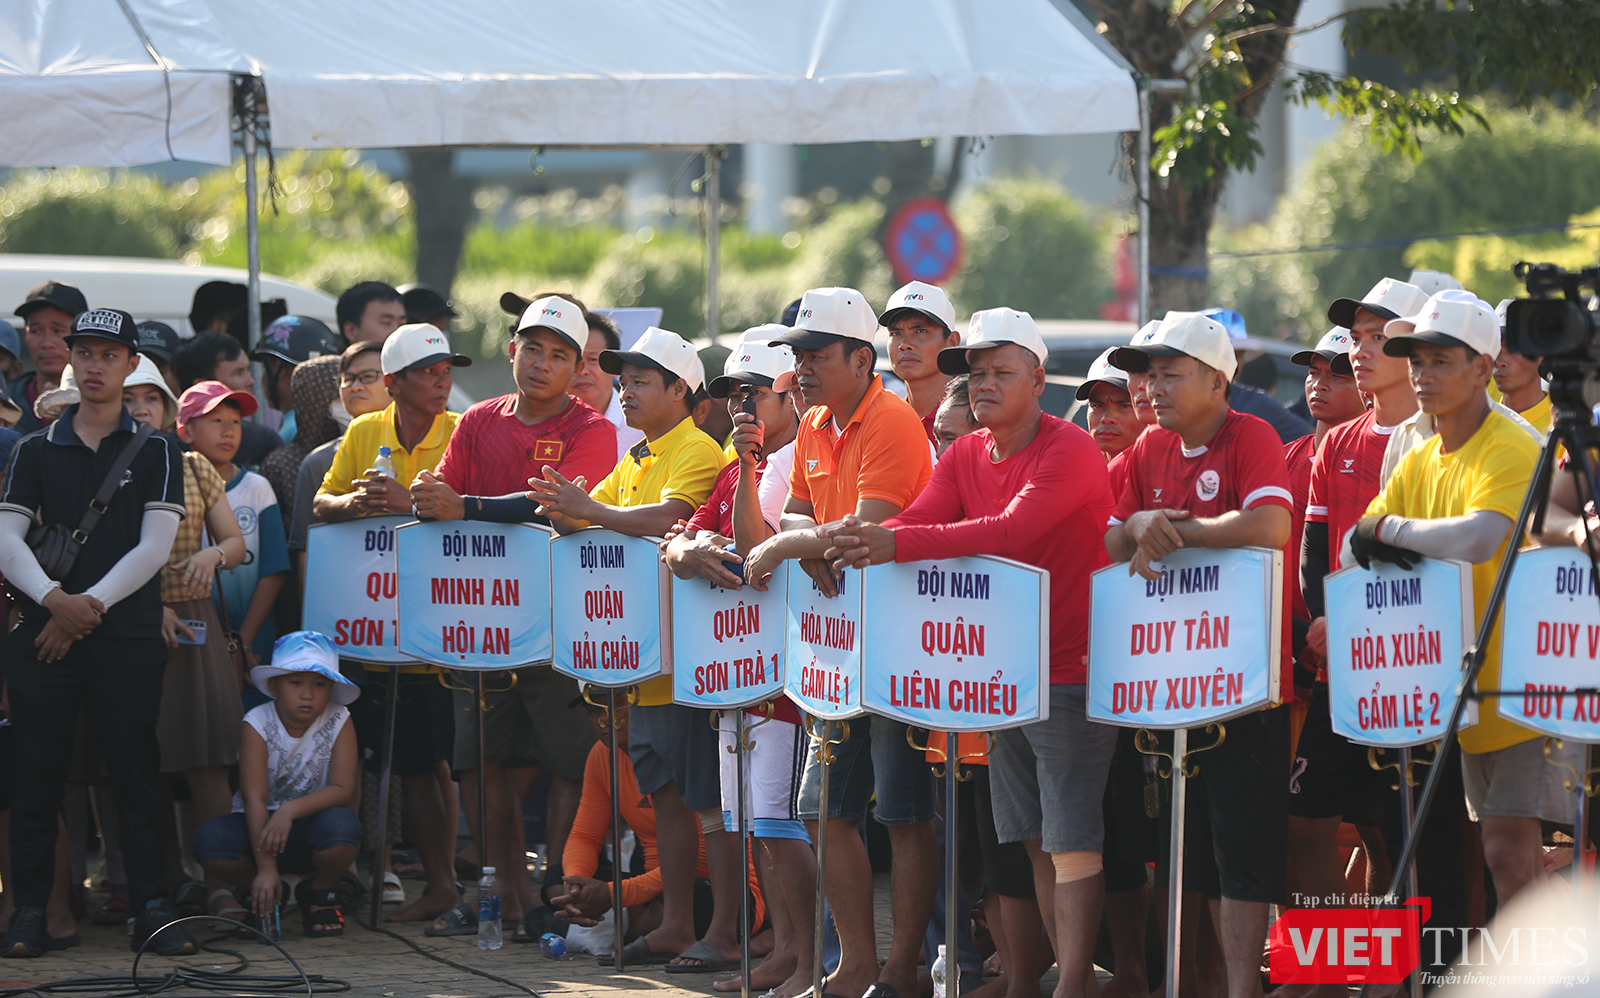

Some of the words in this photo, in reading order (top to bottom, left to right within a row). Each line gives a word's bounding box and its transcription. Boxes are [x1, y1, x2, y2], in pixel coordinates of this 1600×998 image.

[98, 316, 119, 327] YORK
[542, 309, 562, 318] VTV8
[365, 525, 394, 556] ĐỘI
[442, 530, 466, 561] ĐỘI
[472, 535, 505, 557] NAM
[580, 541, 598, 573] ĐỘI
[600, 546, 624, 568] NAM
[432, 578, 484, 605] MINH
[492, 579, 519, 606] AN
[918, 566, 945, 601] ĐỘI
[951, 573, 989, 599] NAM
[1146, 565, 1174, 602] ĐỘI
[1180, 566, 1219, 593] NAM
[1366, 576, 1386, 614] ĐỘI
[1392, 578, 1420, 605] NAM
[1556, 561, 1583, 602] ĐỘI
[585, 585, 623, 625] QUẬN
[714, 601, 759, 642] QUẬN
[335, 617, 383, 645] SƠN
[443, 621, 474, 659] HỘI
[483, 628, 509, 654] AN
[801, 606, 821, 645] HÒA
[825, 613, 855, 651] XUÂN
[922, 617, 984, 662] QUẬN
[1131, 621, 1176, 655] DUY
[1185, 611, 1229, 650] TÂN
[1352, 629, 1386, 670] HÒA
[1392, 625, 1440, 667] XUÂN
[1537, 622, 1579, 657] DUY
[573, 632, 597, 668] HẢI
[602, 636, 638, 669] CHÂU
[695, 661, 728, 695] SƠN
[734, 650, 765, 688] TRÀ
[772, 654, 778, 681] 1
[802, 656, 825, 700] CẨM
[829, 667, 840, 710] LỆ
[844, 677, 848, 705] 1
[1113, 680, 1157, 714] DUY
[1166, 668, 1242, 709] XUYÊN
[891, 670, 939, 709] LIÊN
[949, 670, 1016, 715] CHIỂU
[1359, 683, 1397, 729] CẨM
[1404, 686, 1423, 733] LỆ
[1430, 693, 1440, 725] 2
[1523, 684, 1567, 720] DUY
